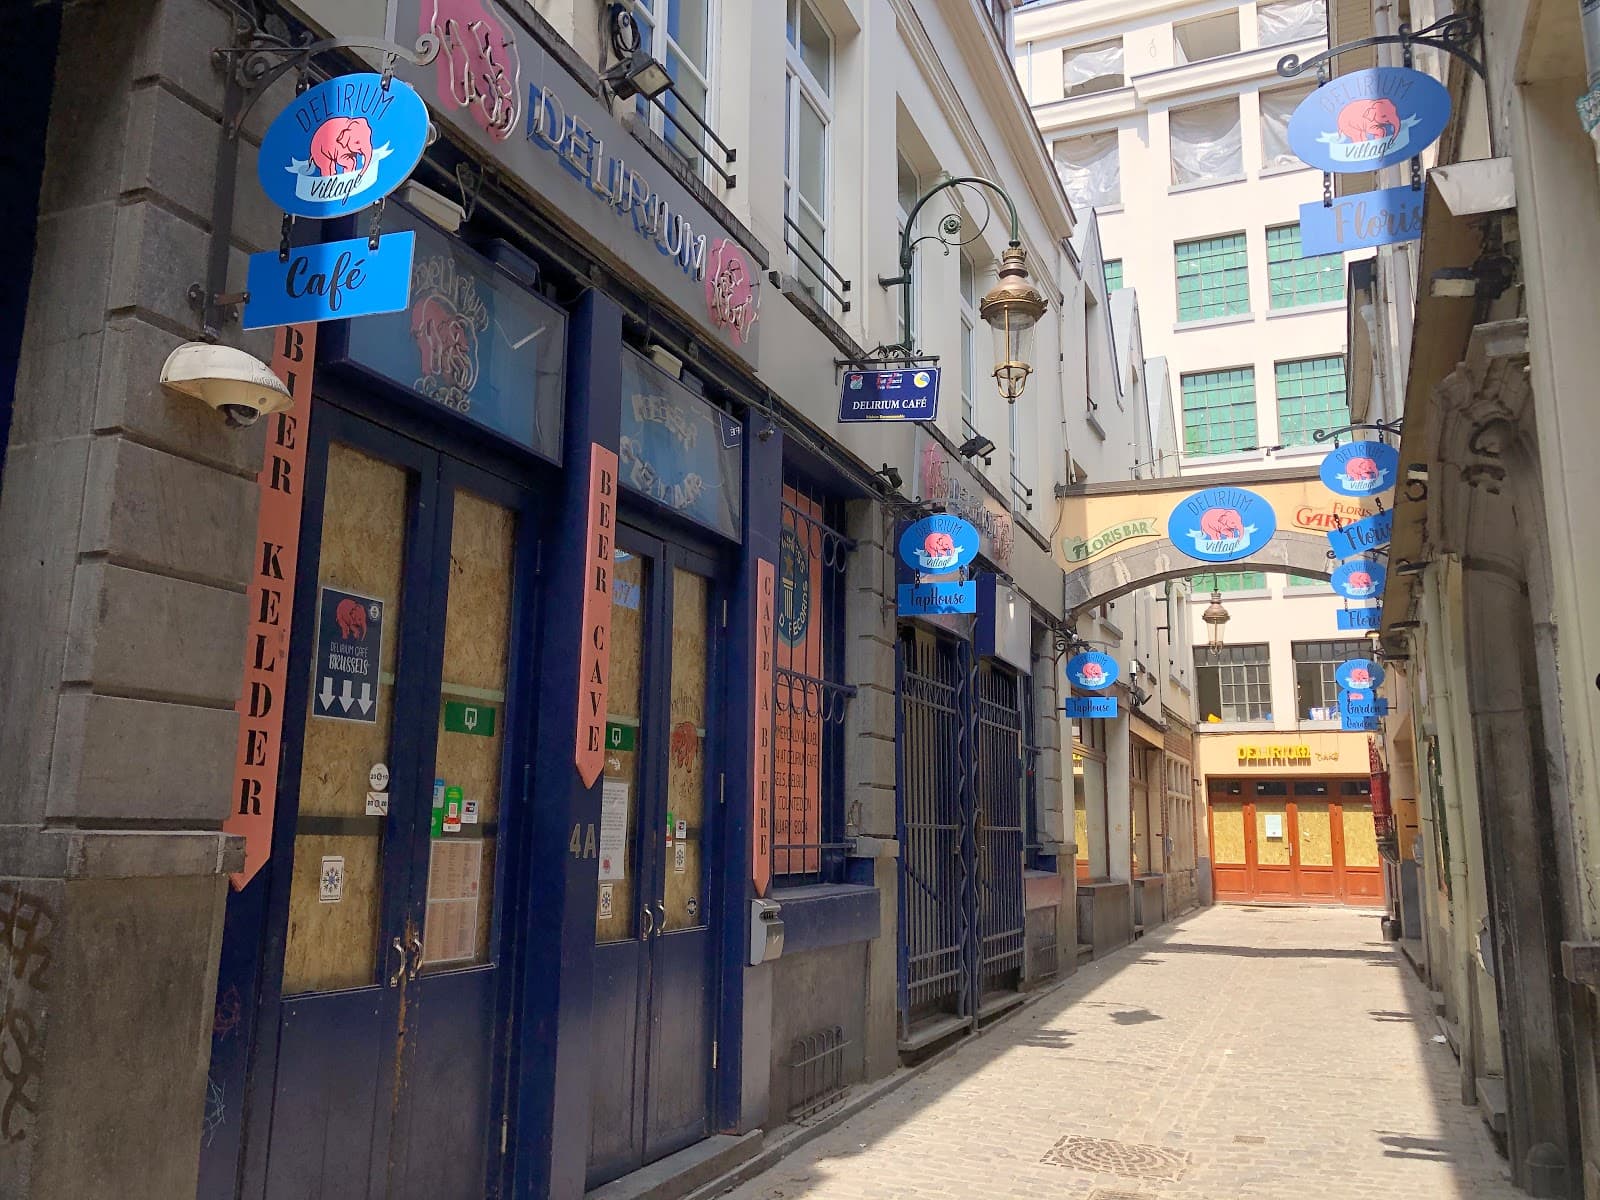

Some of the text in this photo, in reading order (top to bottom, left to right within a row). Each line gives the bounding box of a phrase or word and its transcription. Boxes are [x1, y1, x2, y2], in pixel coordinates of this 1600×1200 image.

[296, 82, 395, 133] DELIRIUM
[1320, 75, 1414, 113] DELIRIUM
[1345, 138, 1396, 162] Village
[311, 175, 363, 206] Village
[527, 82, 707, 282] DELIRIUM
[1330, 200, 1423, 244] Floris
[285, 251, 367, 311] Café
[853, 397, 927, 410] DELIRIUM CAFÉ
[1187, 490, 1254, 516] DELIRIUM
[1333, 502, 1373, 517] FLORIS
[1072, 521, 1149, 560] FLORIS BAR
[1206, 539, 1241, 557] Village
[238, 325, 304, 816] BIER KELDER
[588, 468, 612, 753] BEER CAVE
[909, 587, 966, 608] TapHouse
[762, 575, 772, 673] CAVE
[329, 654, 369, 676] BRUSSELS
[330, 642, 354, 656] DELIRIUM
[761, 693, 769, 711] A
[569, 823, 597, 859] 4A
